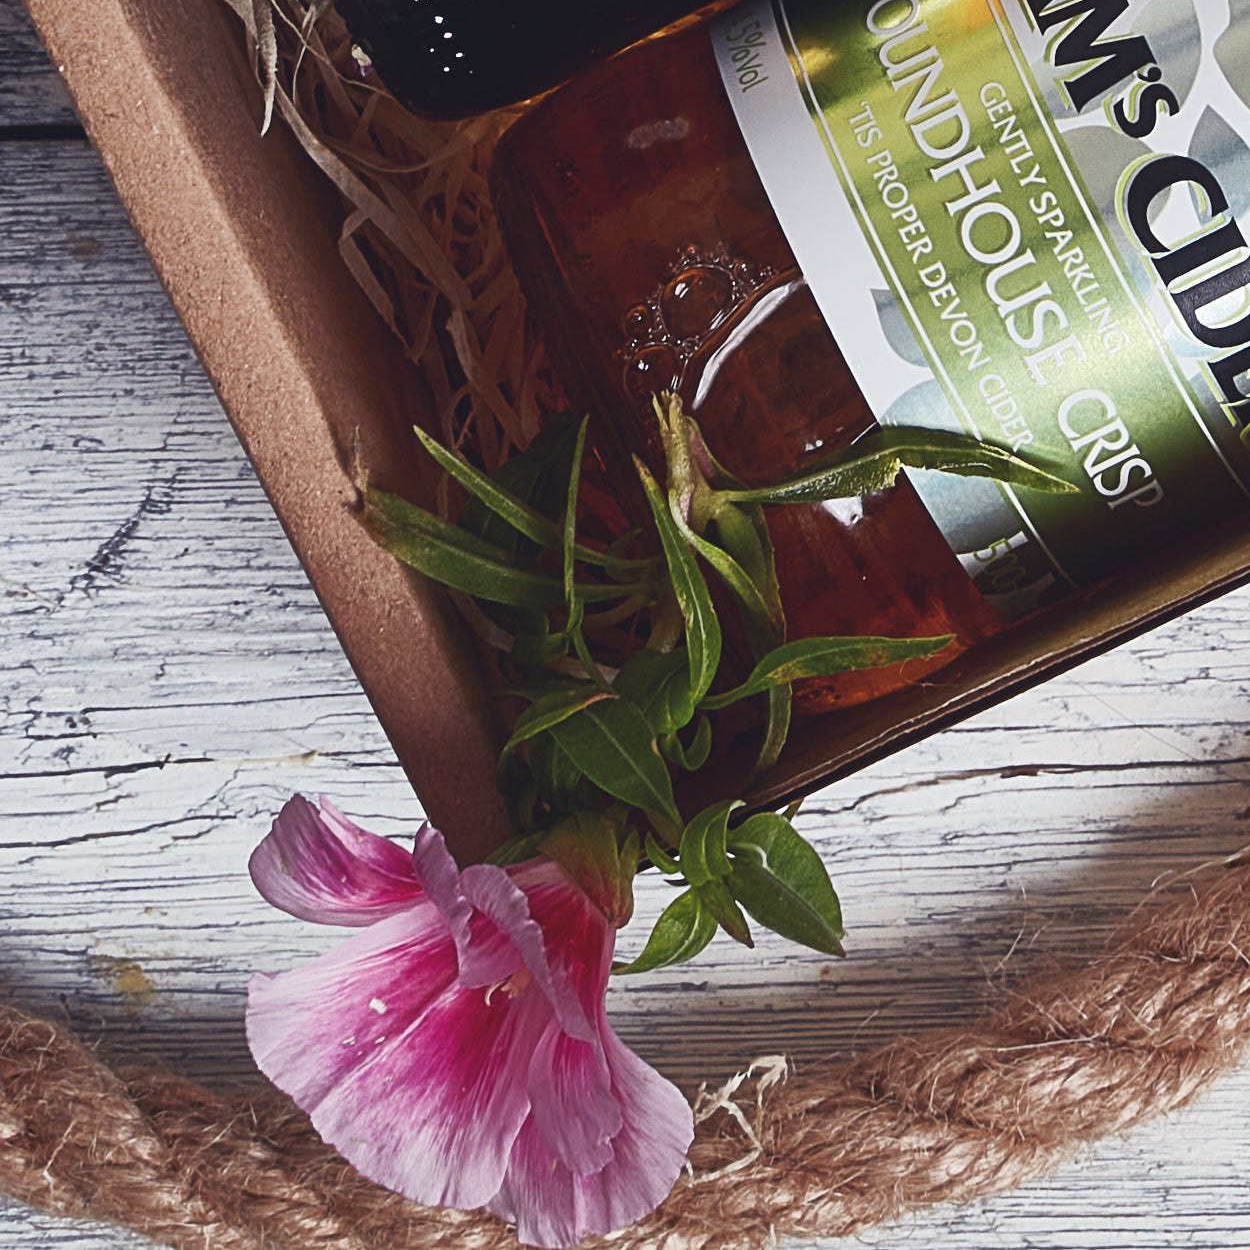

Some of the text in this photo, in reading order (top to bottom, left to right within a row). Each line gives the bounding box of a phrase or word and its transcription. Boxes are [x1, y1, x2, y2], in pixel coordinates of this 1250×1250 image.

[867, 149, 934, 265] PROPER
[919, 261, 992, 372] DEVON
[978, 373, 1035, 453] CIDER
[979, 82, 1130, 356] GENTLY SPARKLING
[1058, 389, 1164, 511] CRISP
